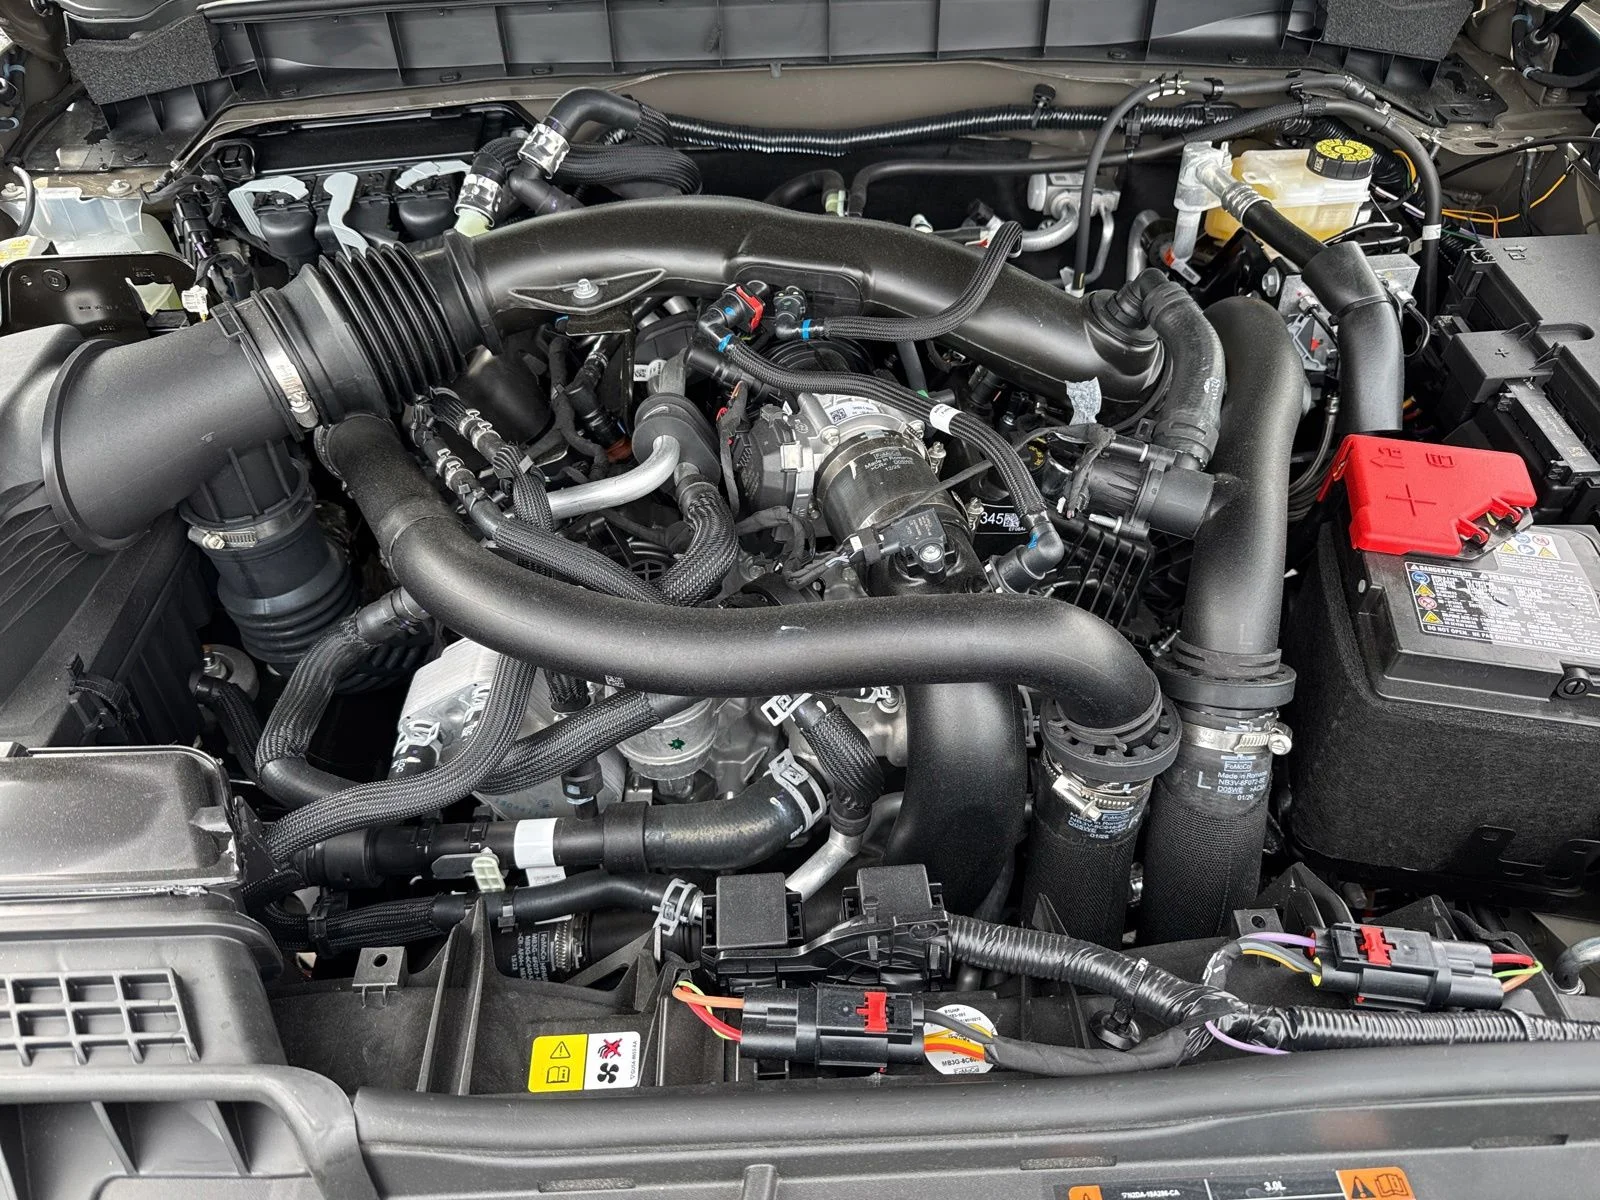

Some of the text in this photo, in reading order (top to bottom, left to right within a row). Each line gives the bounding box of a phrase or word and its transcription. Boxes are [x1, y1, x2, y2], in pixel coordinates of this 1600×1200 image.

[980, 511, 1004, 525] 345
[1419, 565, 1472, 577] DANGER/POISON
[1197, 771, 1212, 790] L
[1217, 771, 1237, 779] Made
[1263, 1181, 1287, 1192] 3.0L
